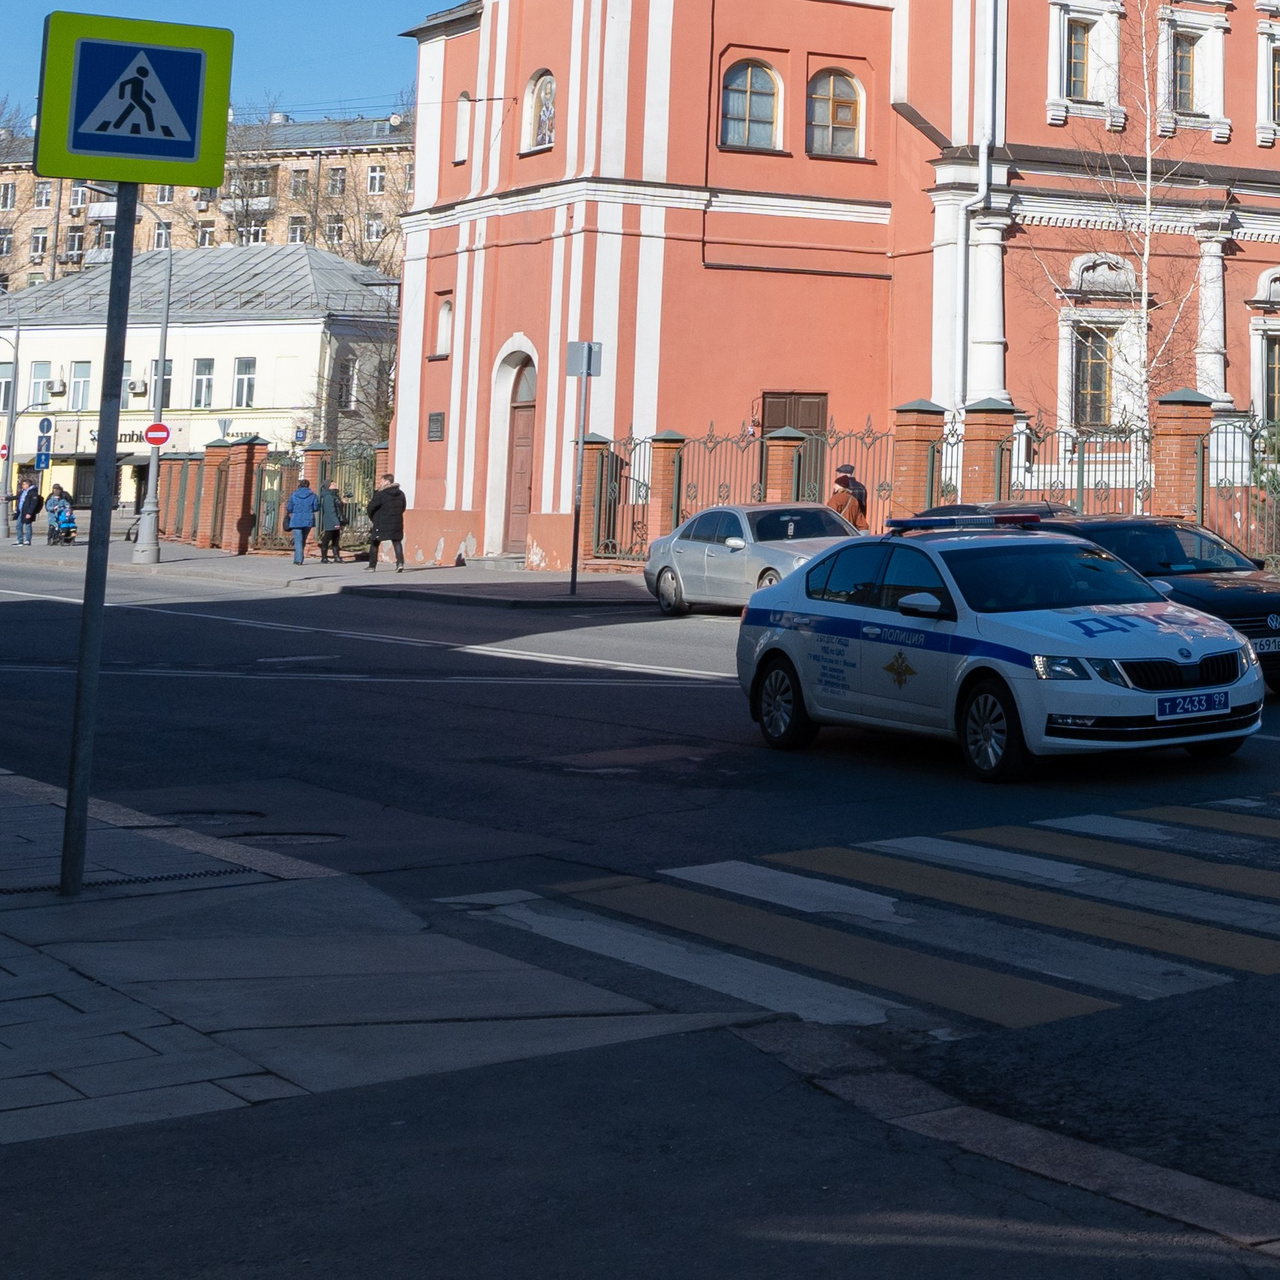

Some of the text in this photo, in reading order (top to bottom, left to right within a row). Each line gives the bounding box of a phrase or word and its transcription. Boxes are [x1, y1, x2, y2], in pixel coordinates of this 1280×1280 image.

[1067, 613, 1199, 638] ДПС
[881, 627, 925, 646] ПОЛИЦИЯ
[1176, 695, 1207, 713] 2433
[1213, 693, 1225, 705] 99
